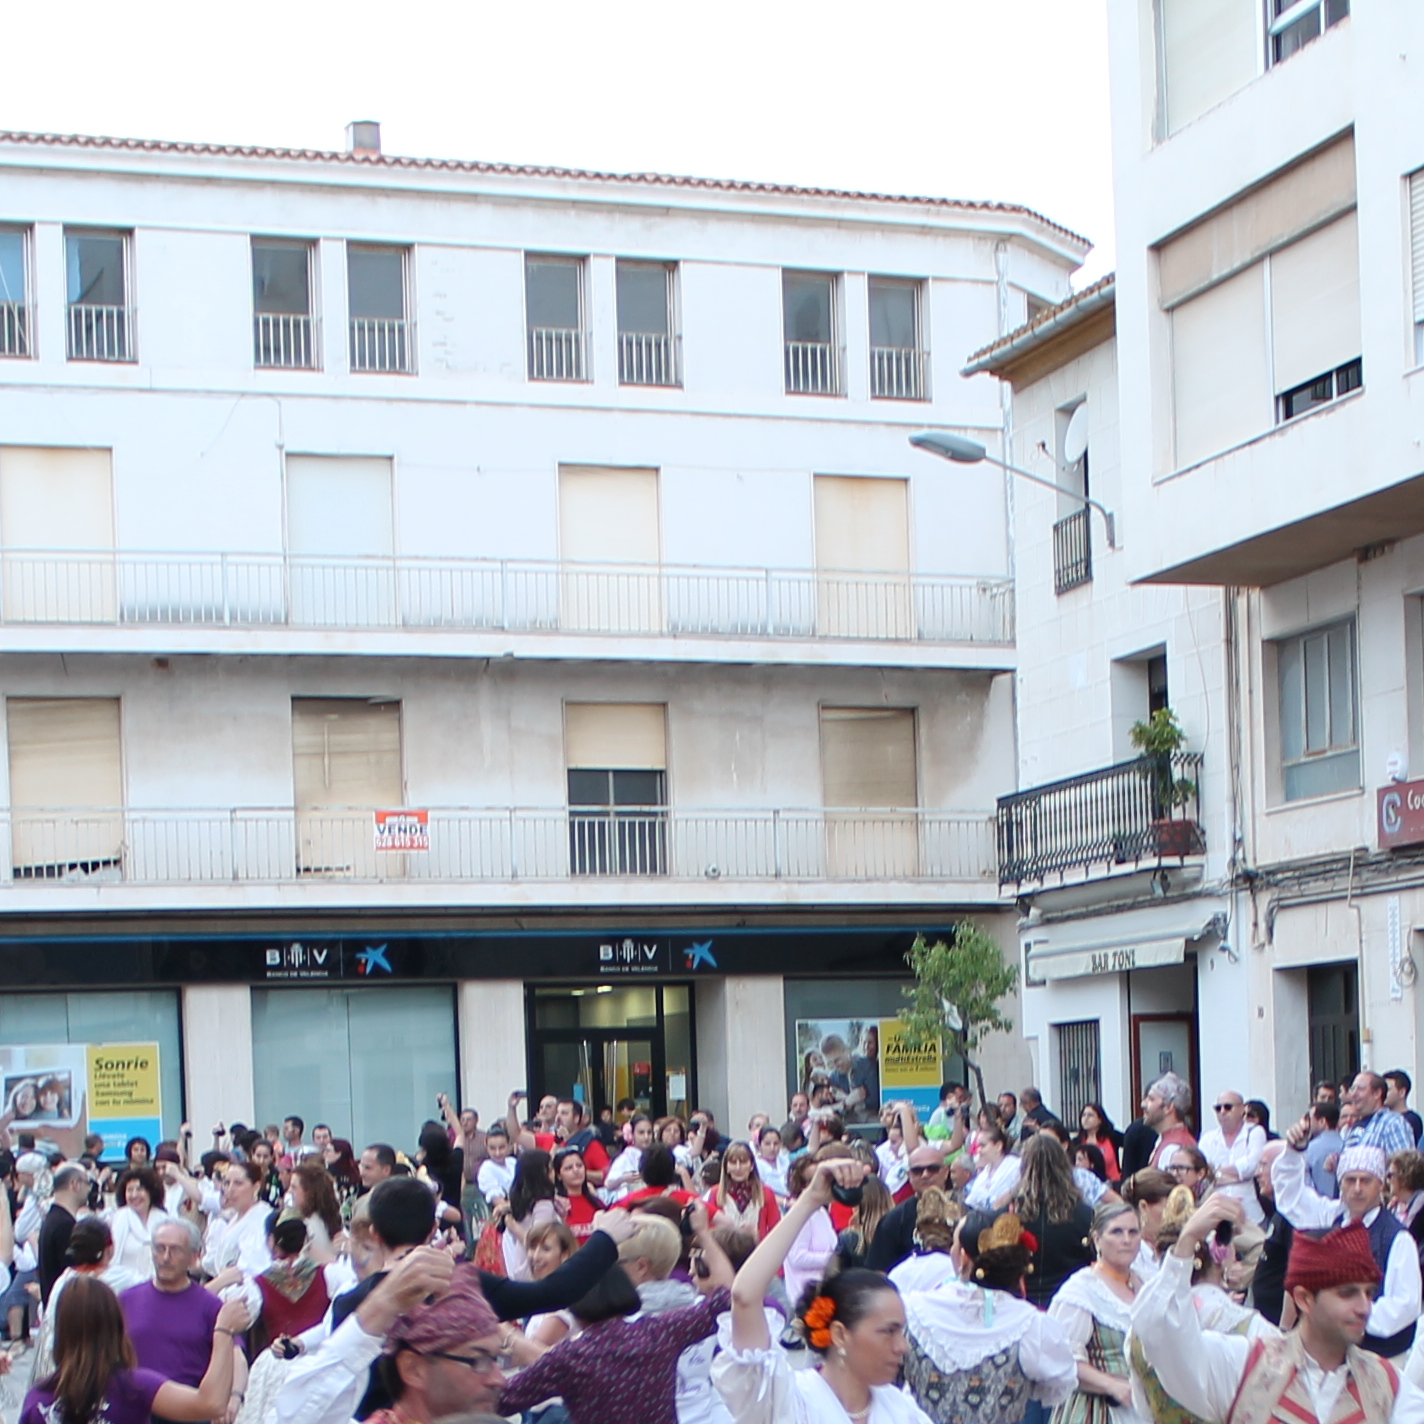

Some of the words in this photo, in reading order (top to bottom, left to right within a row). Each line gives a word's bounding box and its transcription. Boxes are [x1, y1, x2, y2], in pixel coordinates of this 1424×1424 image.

[375, 822, 429, 836] VENDE
[1091, 952, 1109, 972] BAR
[1111, 949, 1136, 970] TONI
[886, 1042, 937, 1054] FAMILIA
[113, 1080, 138, 1088] tablet
[95, 1090, 134, 1098] Samsung
[95, 1099, 110, 1107] con
